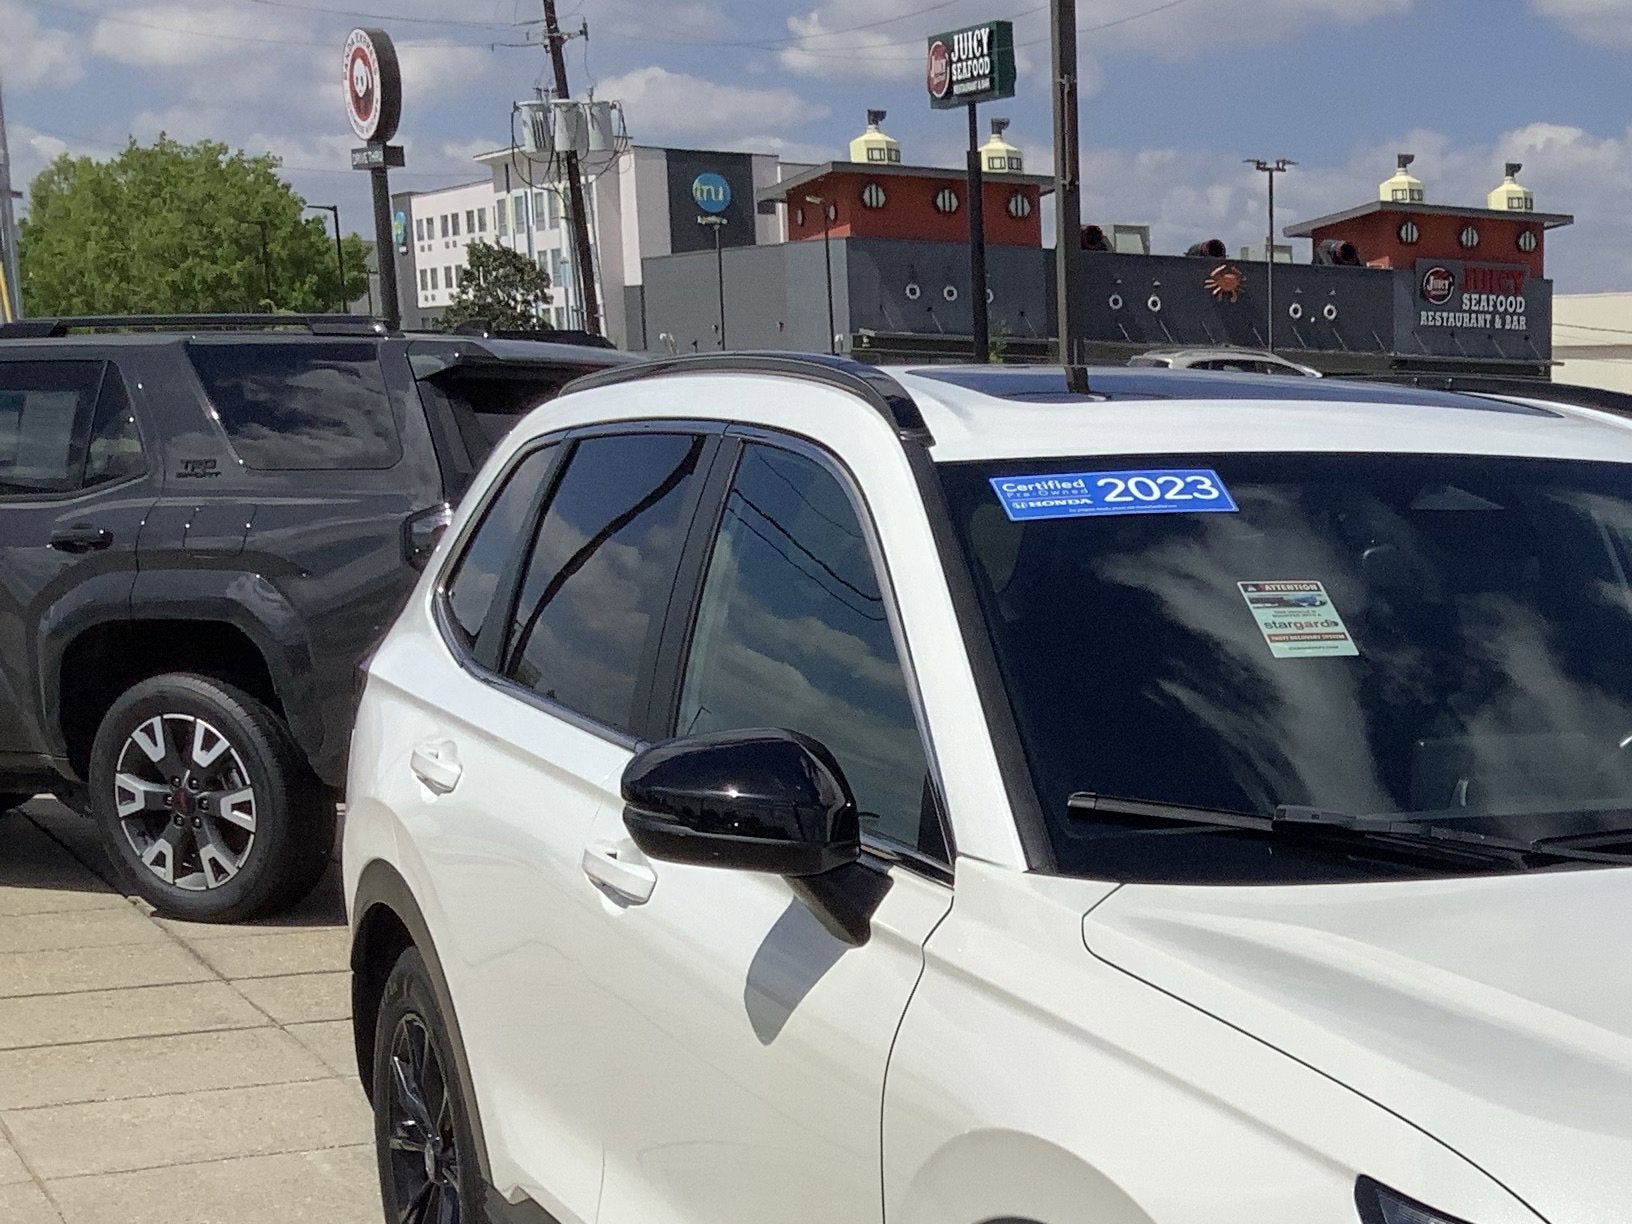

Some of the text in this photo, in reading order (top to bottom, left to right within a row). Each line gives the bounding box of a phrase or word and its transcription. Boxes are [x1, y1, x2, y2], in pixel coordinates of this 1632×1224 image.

[951, 27, 989, 62] JUICY
[951, 56, 990, 81] SEAFOOD
[1459, 268, 1524, 295] JUICY
[1462, 292, 1526, 313] SEAFOOD
[1420, 310, 1527, 331] RESTAURANT & BAR
[180, 459, 217, 471] TRD
[1002, 476, 1219, 502] Certified 2023
[1028, 498, 1093, 508] HONDA
